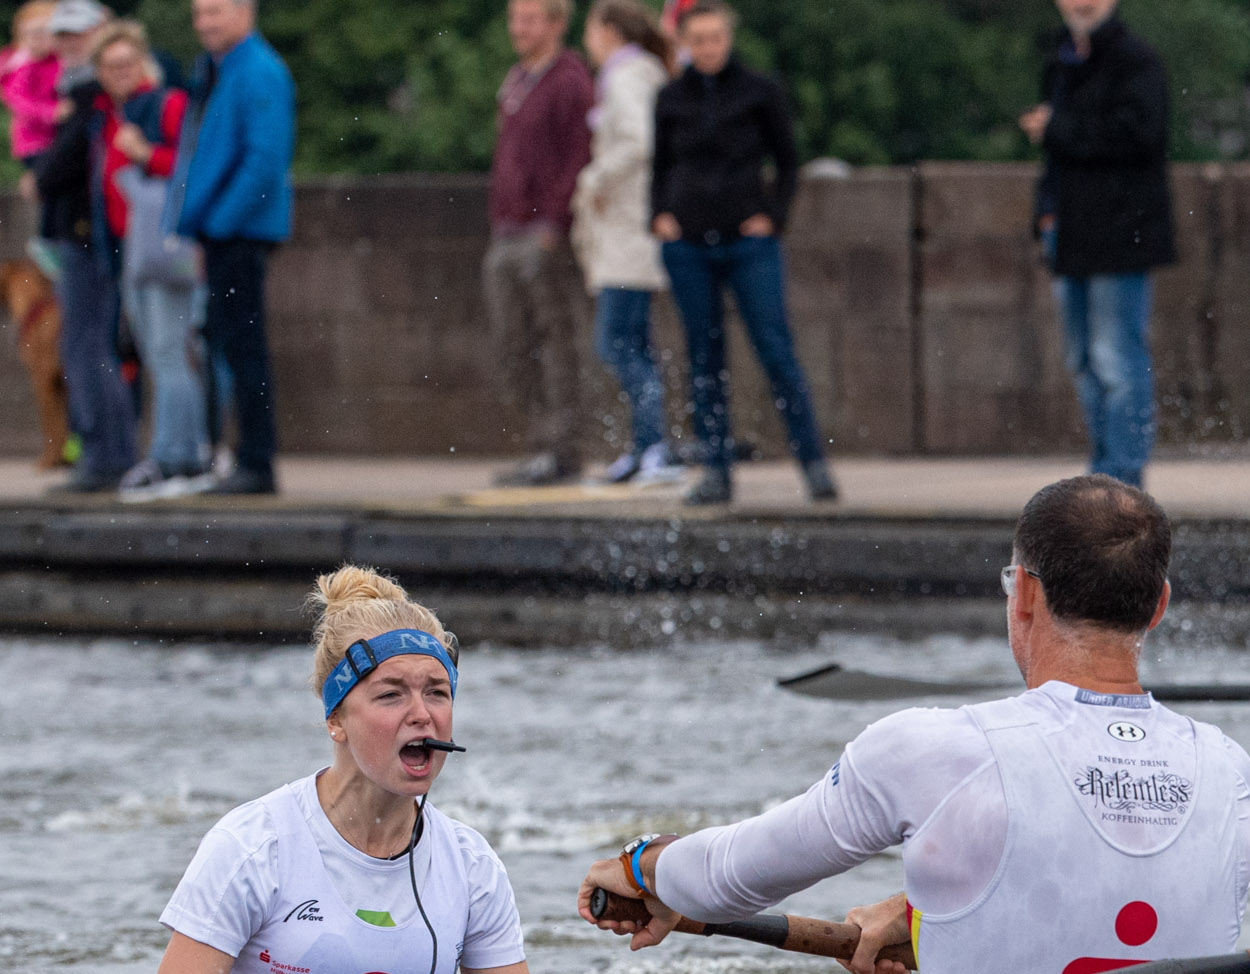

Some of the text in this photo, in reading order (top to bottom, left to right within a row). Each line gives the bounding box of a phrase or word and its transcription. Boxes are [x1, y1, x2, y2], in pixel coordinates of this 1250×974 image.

[1080, 691, 1114, 706] UNDER
[1097, 755, 1169, 768] ENERGY DRINK
[1076, 767, 1192, 809] Relentless
[1101, 812, 1178, 826] KOFFEINHALTIG
[271, 960, 310, 974] Sparkasse
